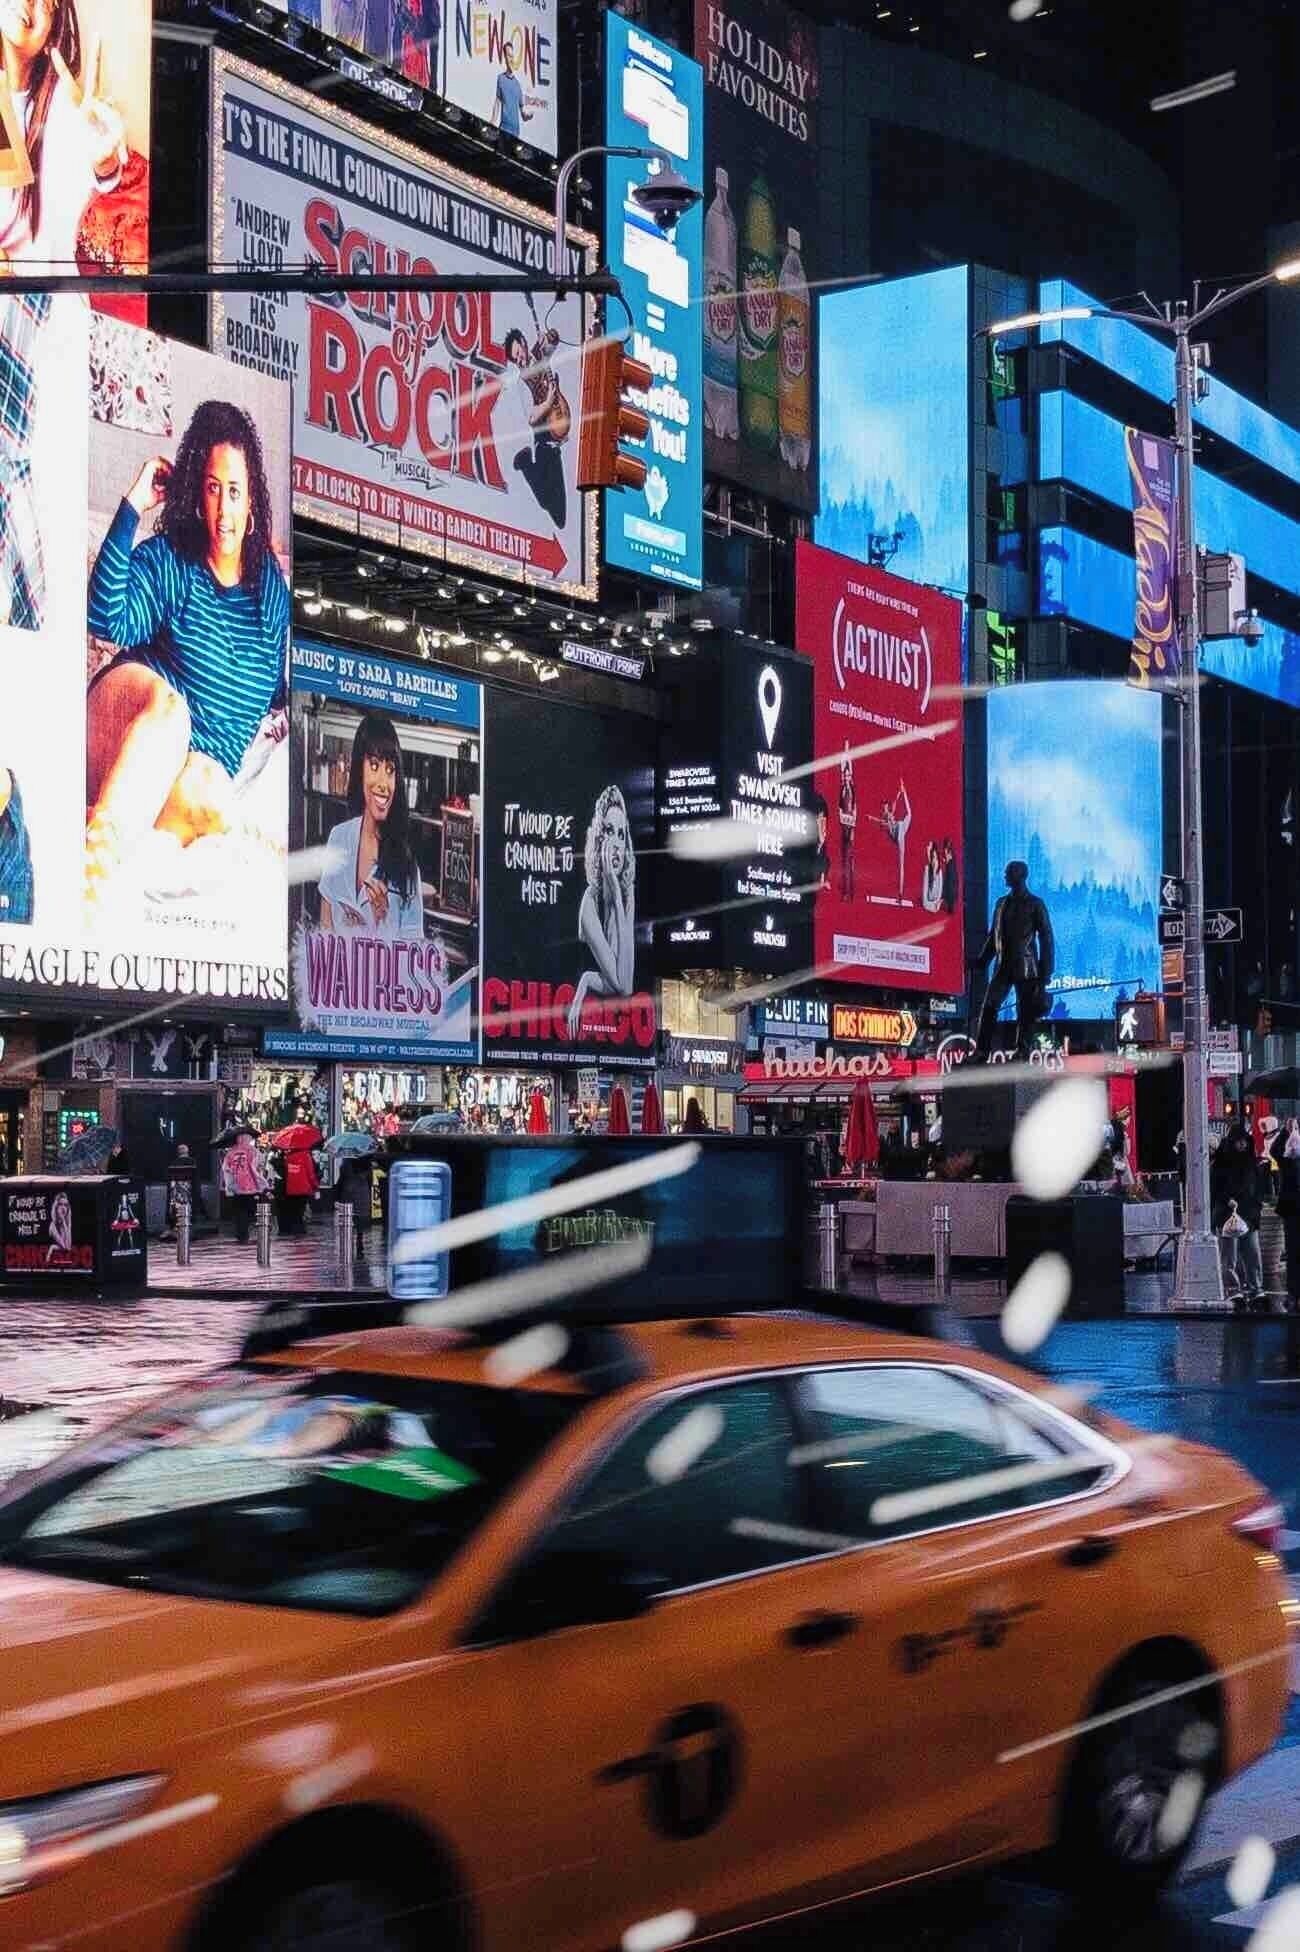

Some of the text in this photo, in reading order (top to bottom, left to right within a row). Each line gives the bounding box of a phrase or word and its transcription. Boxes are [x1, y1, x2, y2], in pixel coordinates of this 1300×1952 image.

[456, 0, 551, 88] NEW ONE
[707, 3, 808, 101] HOLIDAY
[708, 51, 808, 141] FAVORITES
[256, 113, 289, 166] THE
[292, 130, 341, 188] FINAL
[344, 154, 448, 233] COUNTDOWN!
[451, 201, 490, 248] THRU
[493, 219, 523, 262] JAN
[525, 231, 543, 270] 20
[243, 232, 284, 272] LLOYD
[303, 197, 507, 368] SCHOOL
[250, 296, 276, 331] HAS
[227, 317, 299, 370] BROADWAY
[634, 333, 677, 382] More
[305, 302, 508, 492] ROCK
[650, 420, 687, 464] You!
[395, 458, 432, 483] MUSICAL
[305, 468, 313, 491] 4
[316, 471, 360, 506] BLOCKS
[363, 487, 378, 511] TO
[380, 491, 400, 519] THE
[403, 500, 444, 533] WINTER
[446, 514, 487, 546] GARDEN
[489, 527, 532, 560] THEATRE
[291, 646, 458, 701] MUSIC BY SARA BAREILLES
[565, 645, 641, 677] OUTFRONT PRIME
[757, 751, 784, 777] VISIT
[738, 774, 801, 808] SWAROVSKI
[505, 804, 519, 836] IT
[519, 809, 551, 839] WOULD
[554, 815, 574, 840] BE
[731, 799, 808, 836] TIMES SQUARE
[445, 849, 470, 882] EGGS
[505, 842, 574, 873] CRIMINAL TO
[521, 875, 563, 906] MISS IT
[0, 943, 287, 1000] EAGLE OUTFITTERS
[304, 932, 443, 1015] WAITRESS
[1062, 975, 1112, 992] Stanley
[483, 977, 657, 1048] CHICAGO
[806, 1001, 829, 1025] FIN
[836, 1010, 857, 1037] DOS
[763, 1045, 892, 1078] nuchas
